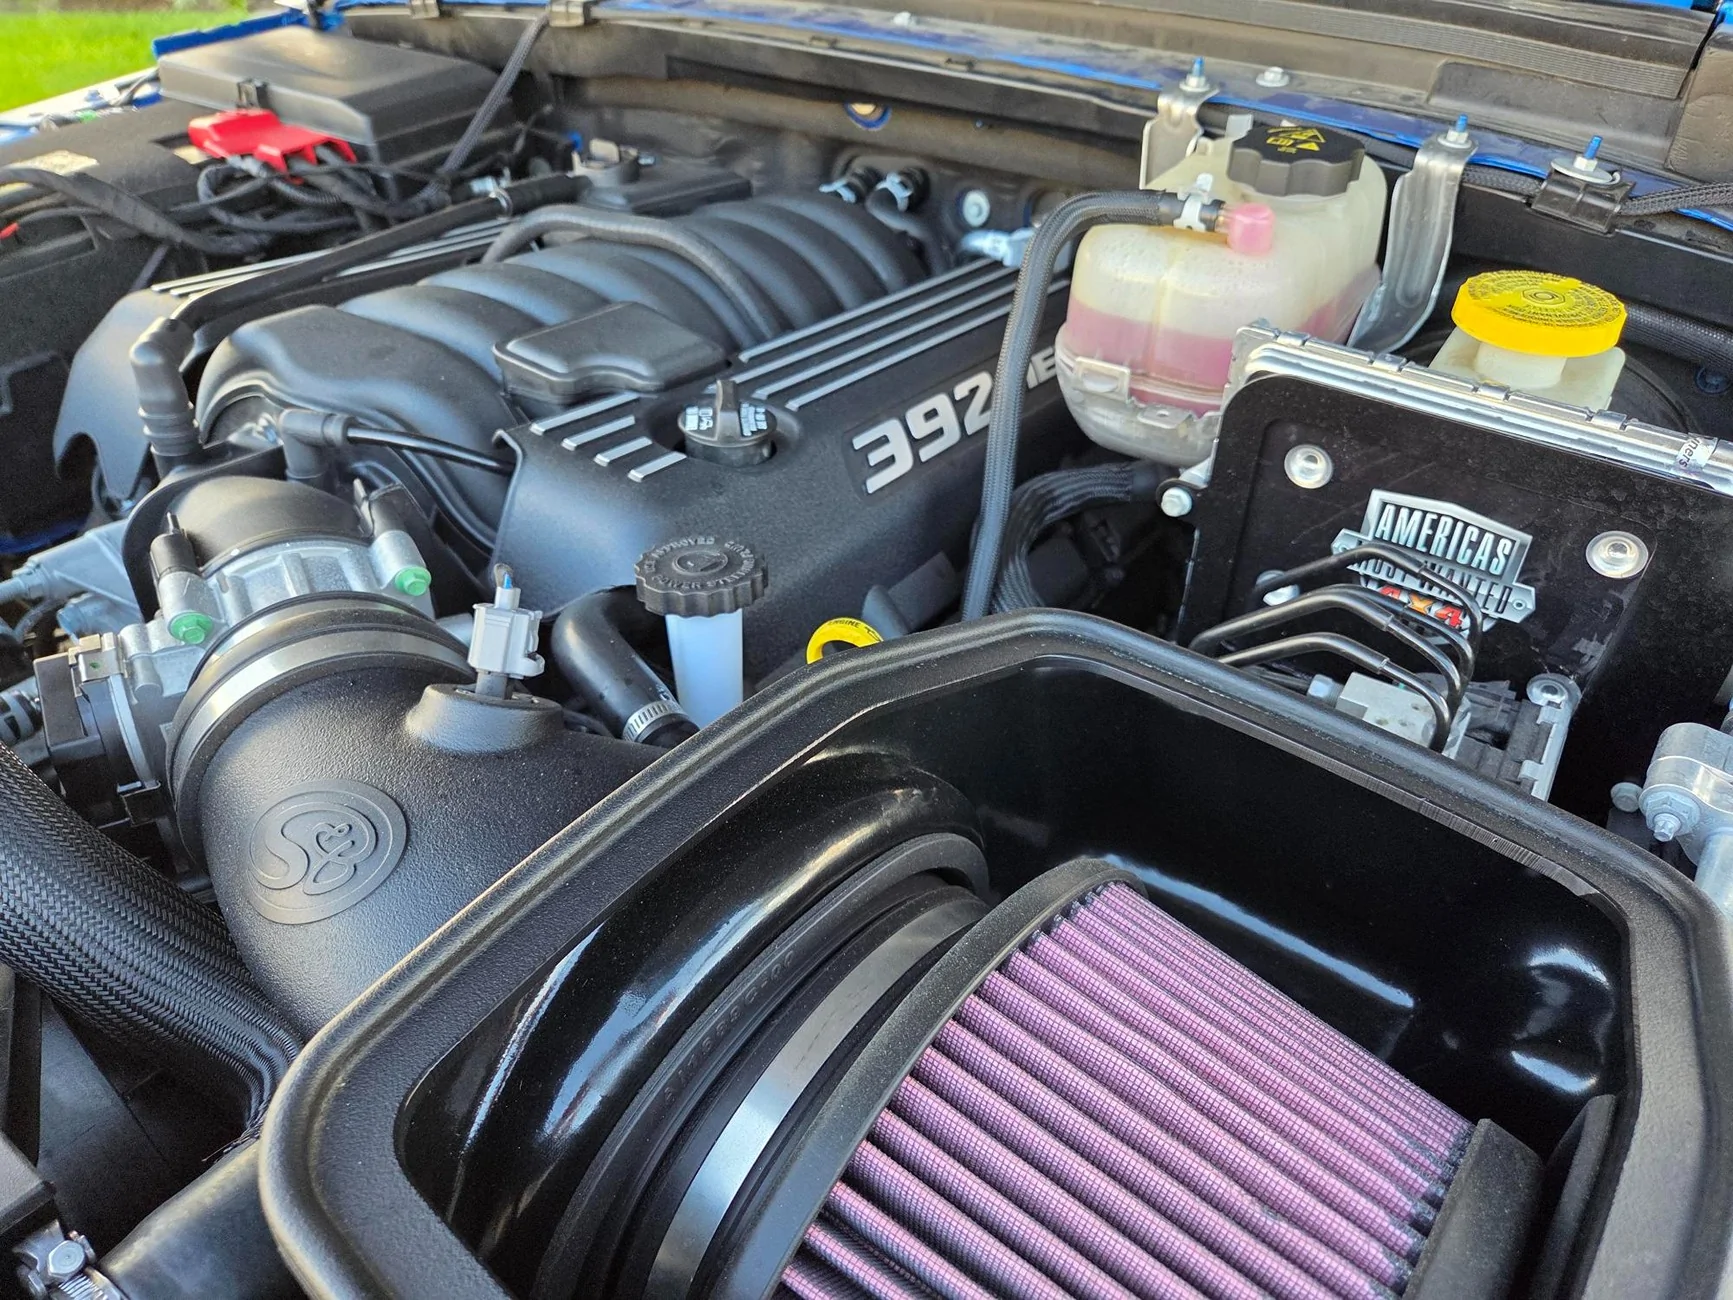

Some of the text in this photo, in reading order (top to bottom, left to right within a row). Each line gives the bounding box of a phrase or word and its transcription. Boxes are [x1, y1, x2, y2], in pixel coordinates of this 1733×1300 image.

[852, 370, 995, 494] 392
[1374, 503, 1513, 576] AMERICAS
[826, 619, 861, 629] ENGINE
